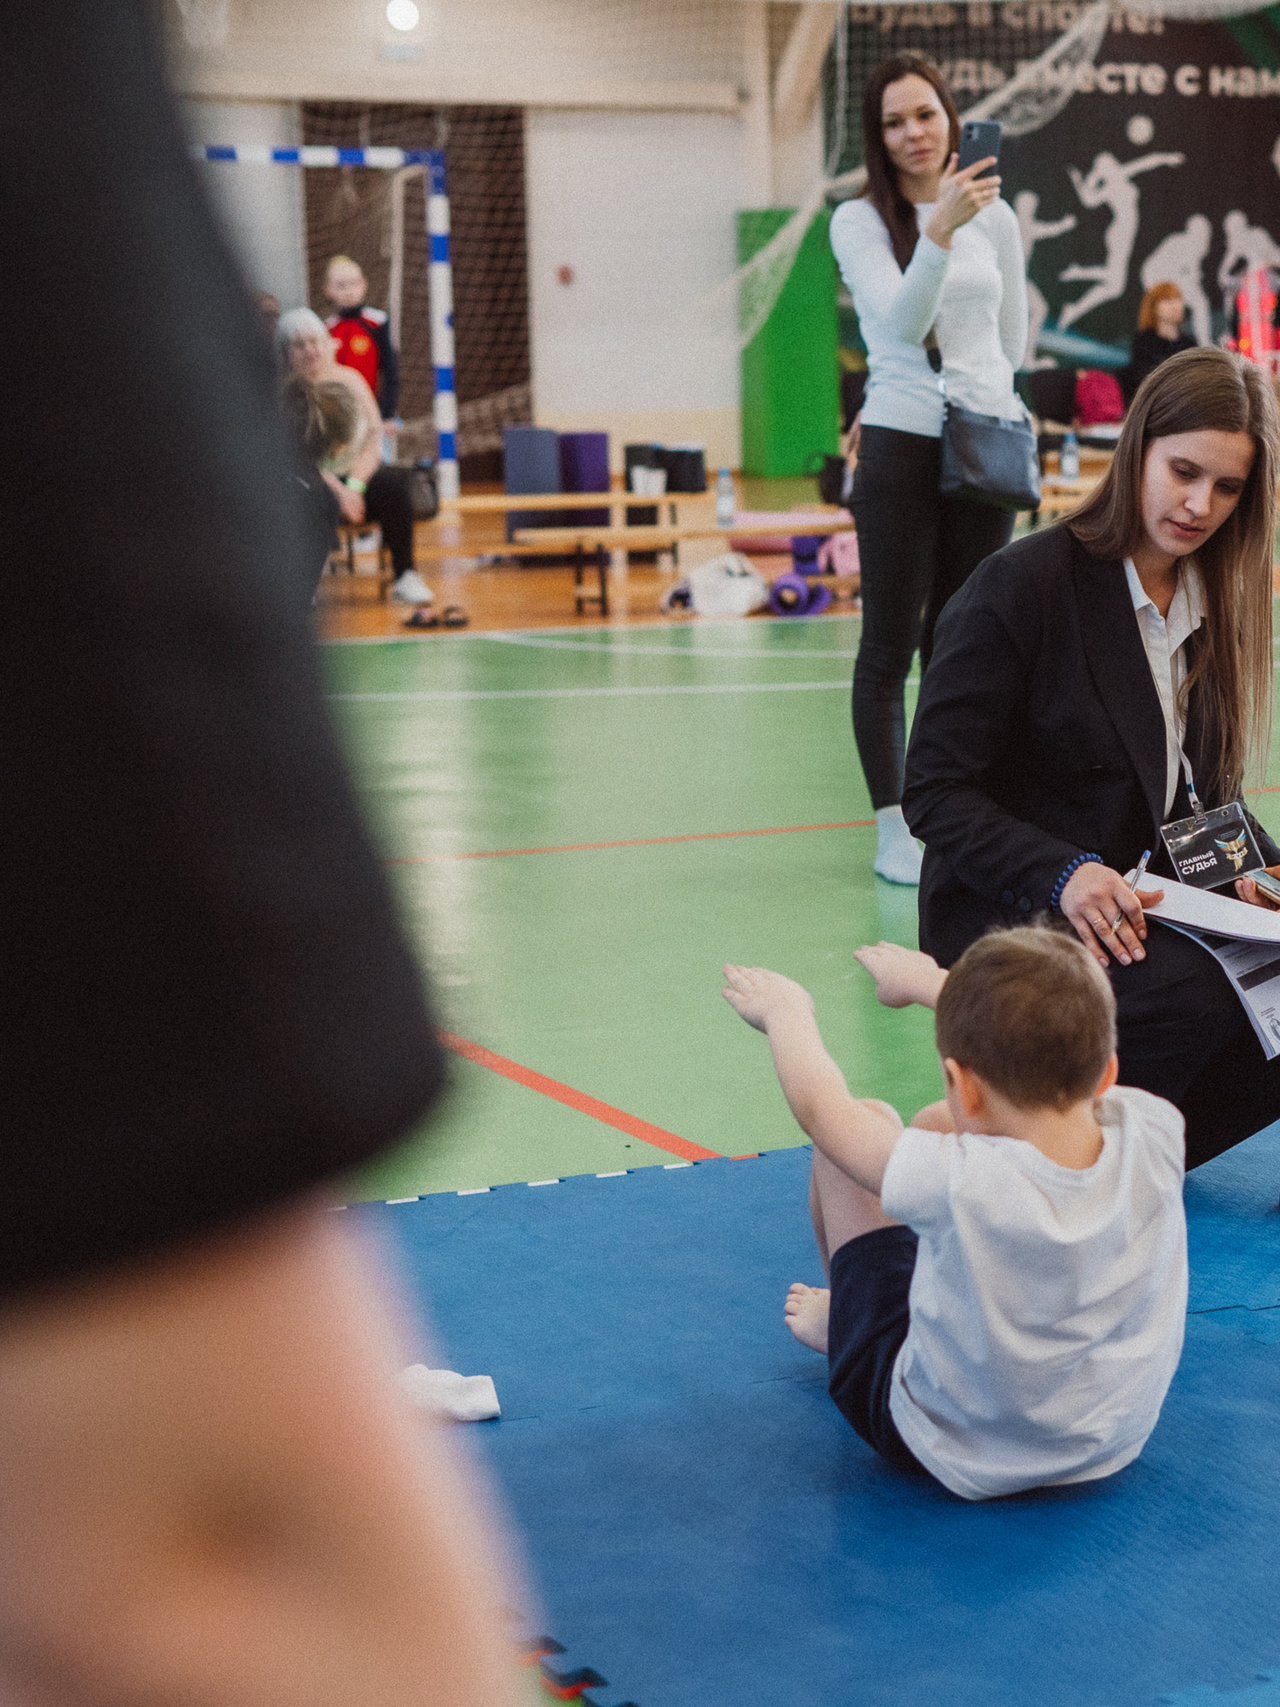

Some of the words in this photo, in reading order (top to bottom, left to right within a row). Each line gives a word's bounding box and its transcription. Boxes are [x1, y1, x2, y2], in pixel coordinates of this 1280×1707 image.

[1174, 63, 1200, 96] с
[1179, 850, 1215, 867] ГЛАВНЫЙ
[1181, 857, 1218, 875] СУДЬЯ
